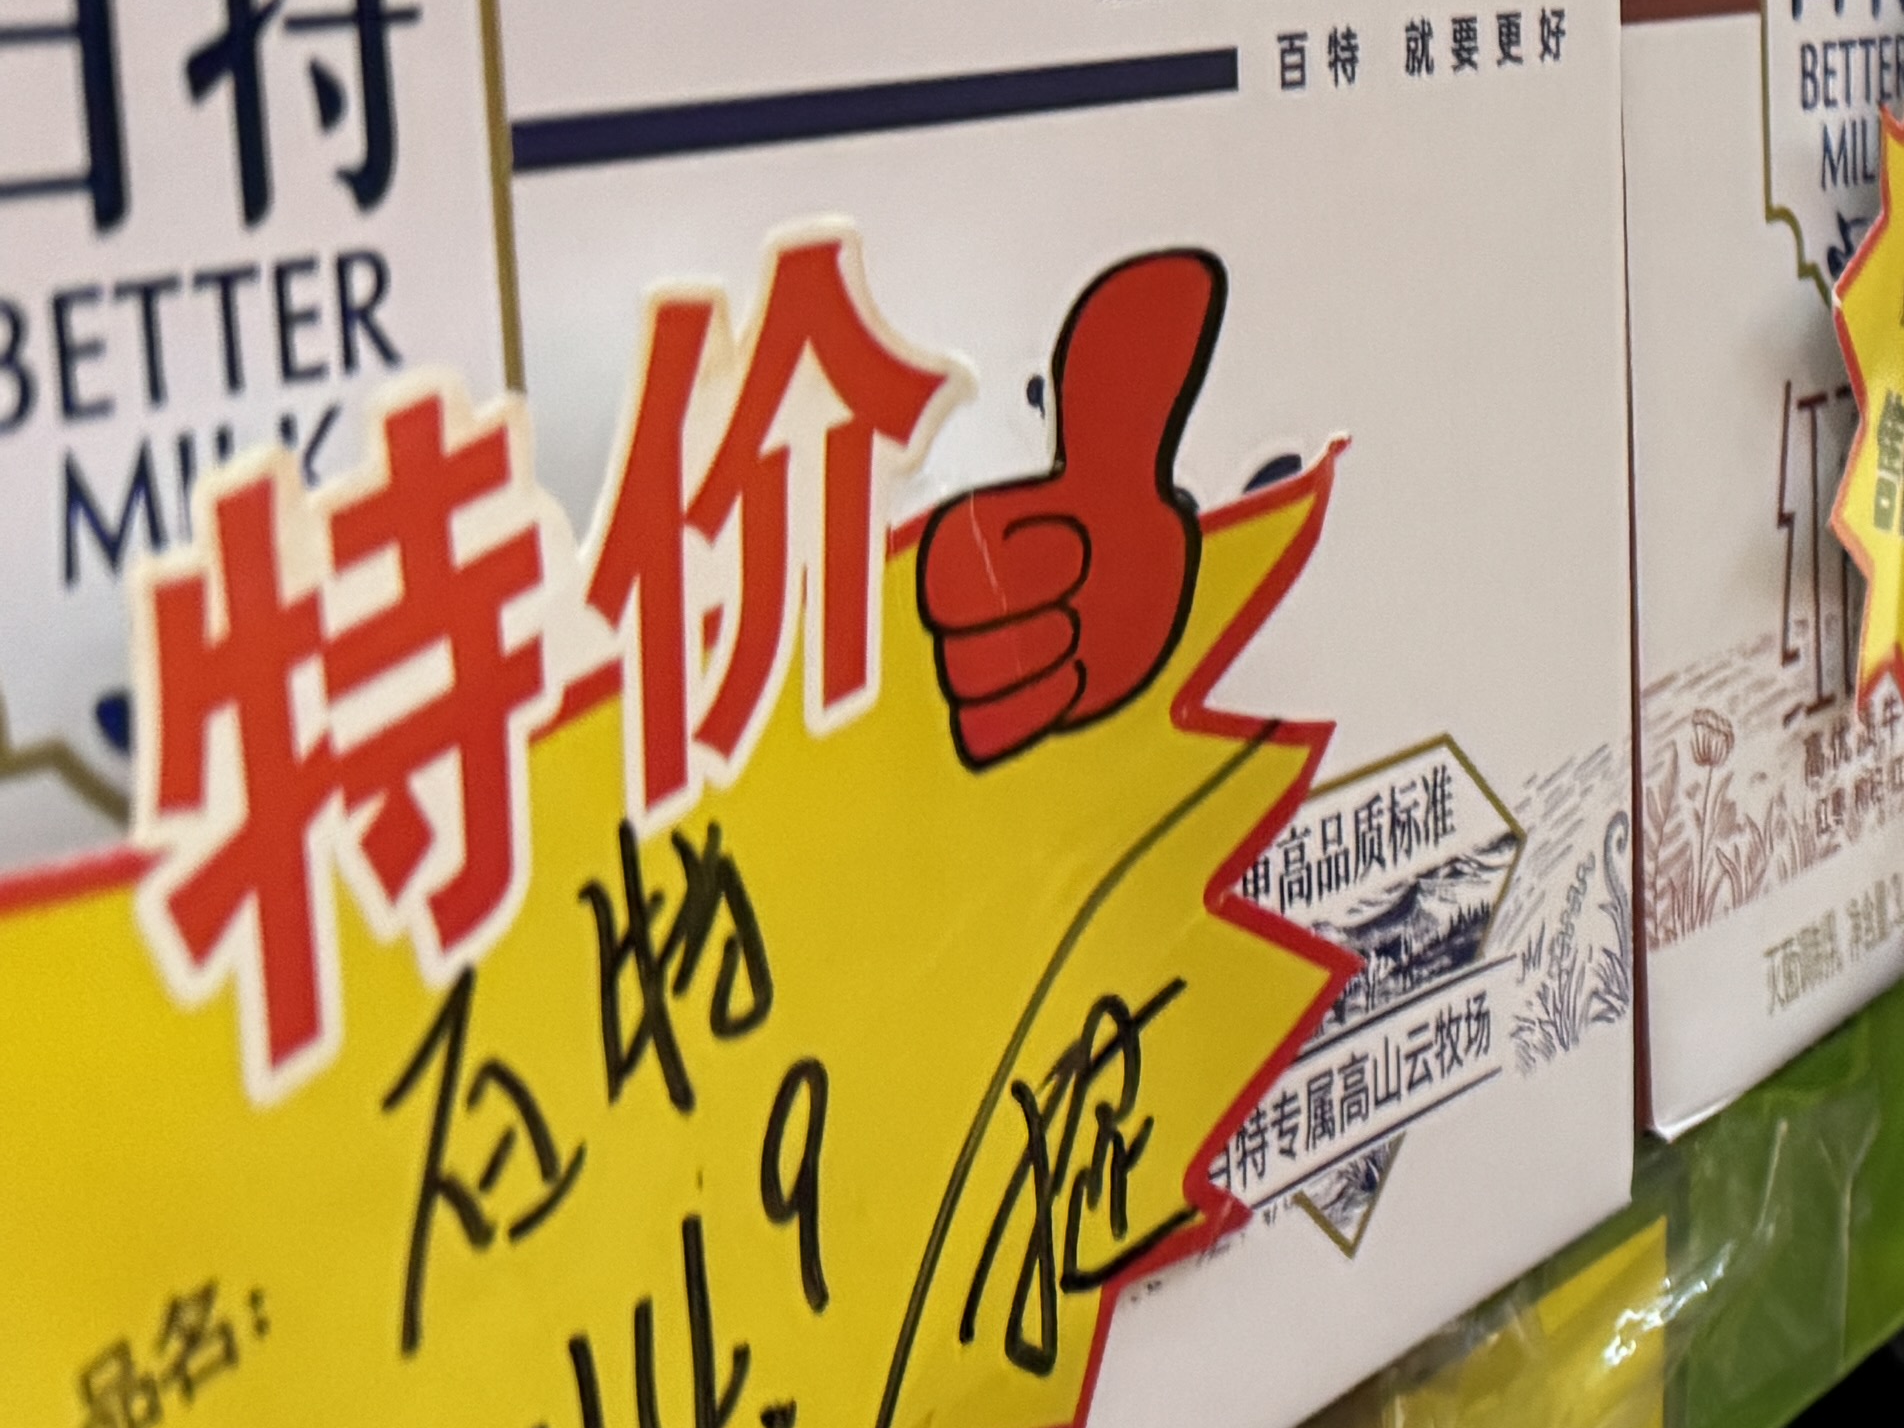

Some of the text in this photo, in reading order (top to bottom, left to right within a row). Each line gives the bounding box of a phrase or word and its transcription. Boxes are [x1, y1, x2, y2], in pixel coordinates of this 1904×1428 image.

[1276, 8, 1567, 92] 百特 就要更好
[1822, 117, 1878, 192] MIL
[145, 232, 955, 1082] 特价
